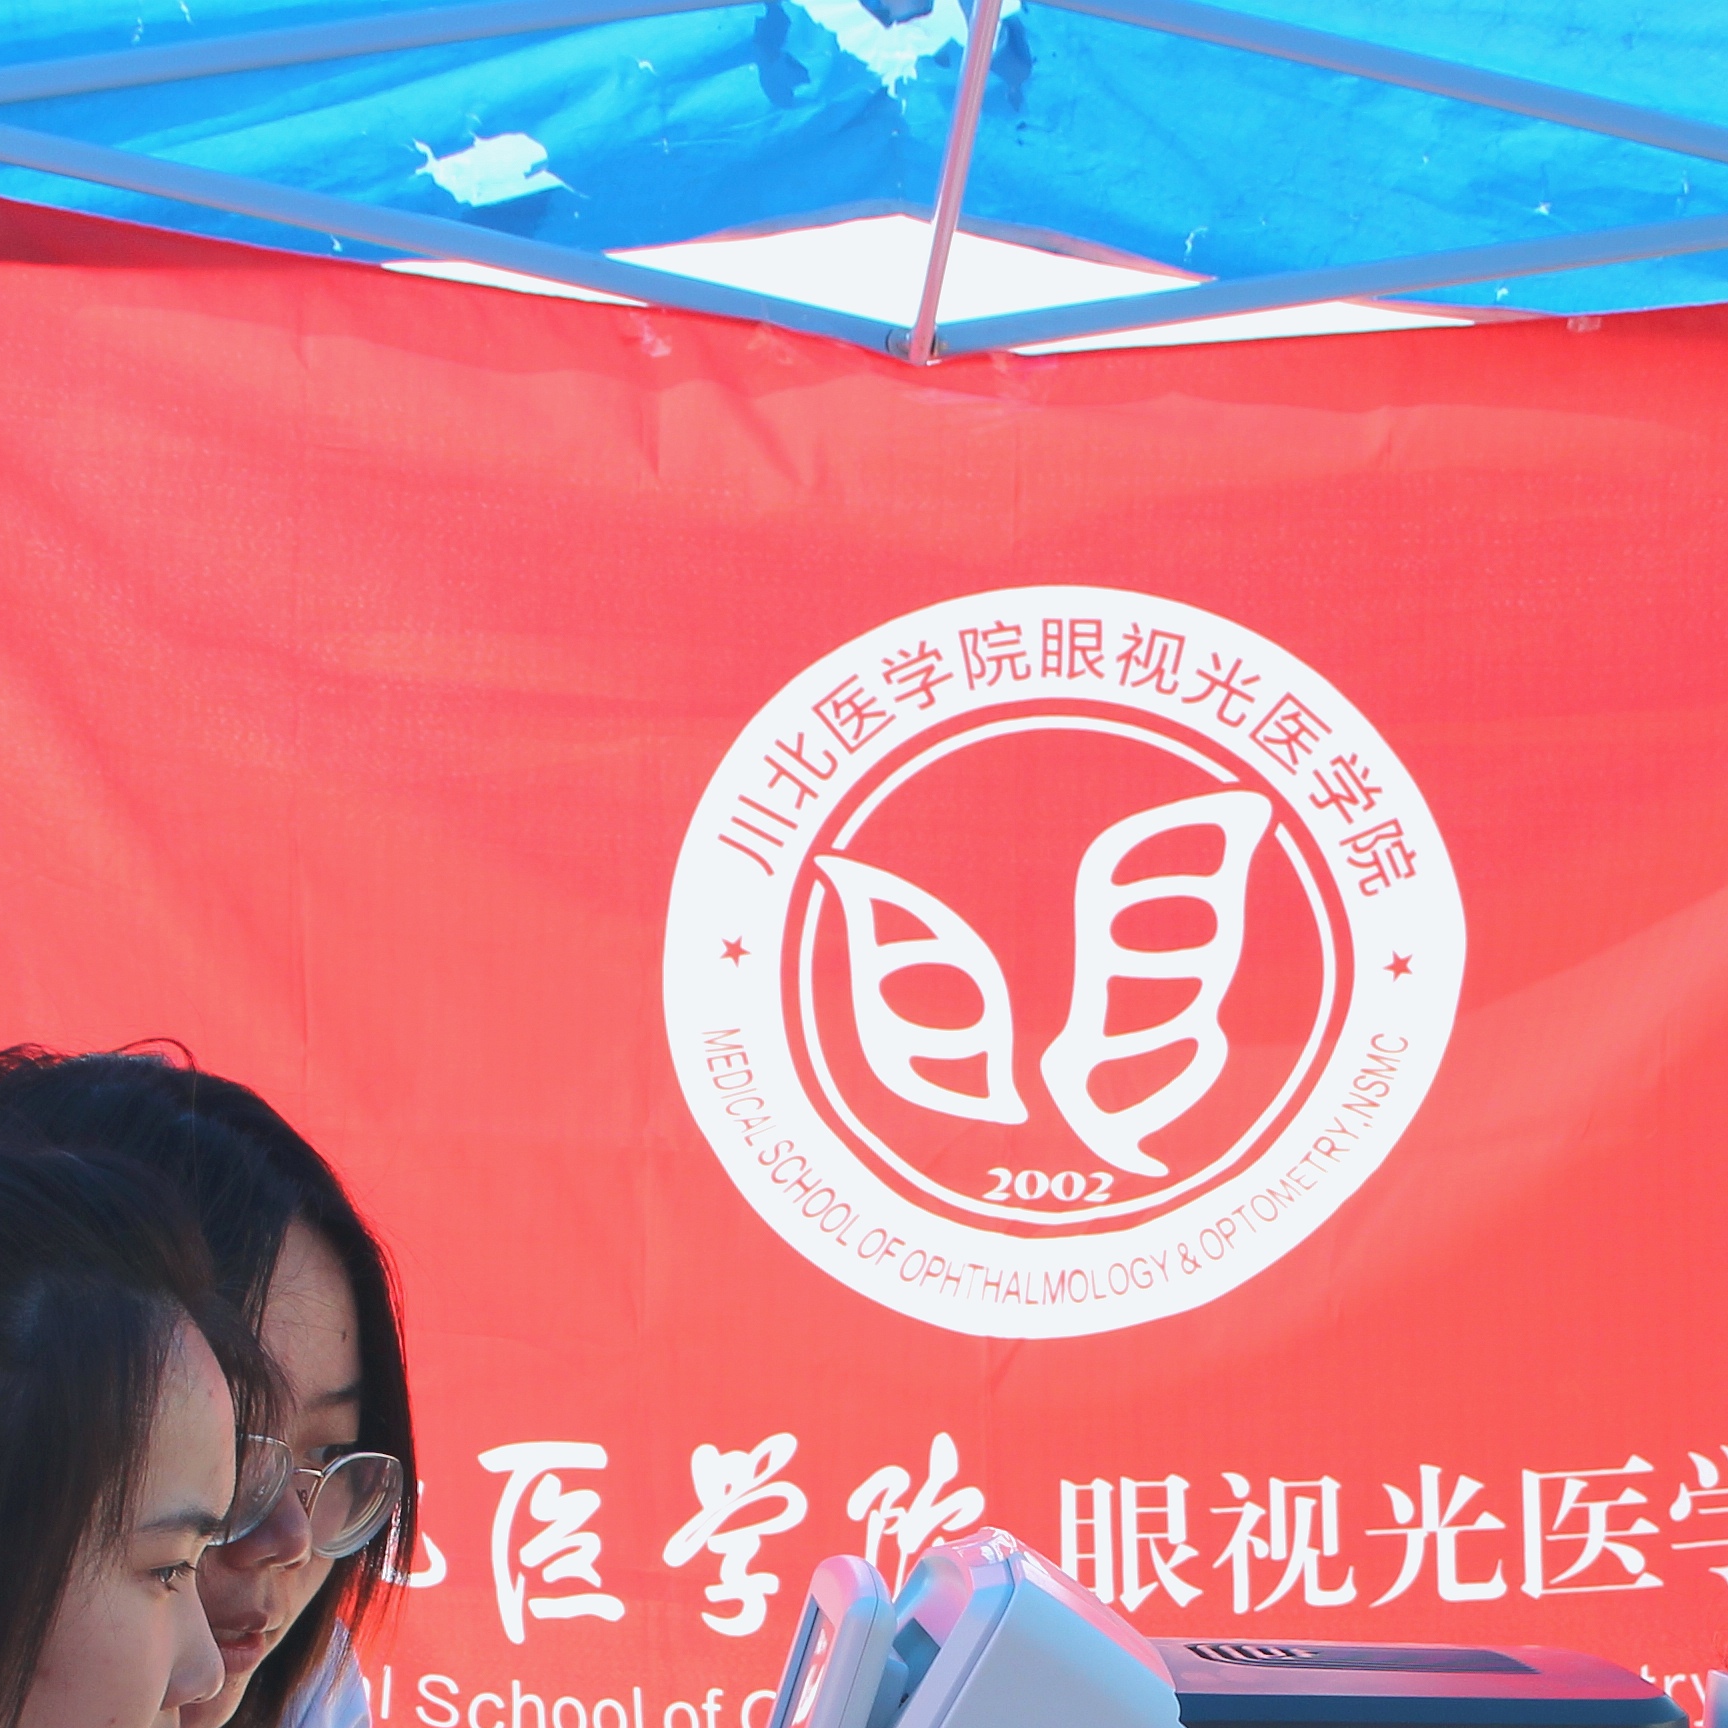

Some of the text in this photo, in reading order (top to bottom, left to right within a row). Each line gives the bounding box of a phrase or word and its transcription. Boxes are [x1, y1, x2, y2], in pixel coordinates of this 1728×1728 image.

[717, 617, 1418, 898] 川北医学院眼视光医学院
[701, 1027, 777, 1148] MEDICAL
[756, 1139, 861, 1248] SCHOOL
[857, 1227, 906, 1266] OF
[898, 1248, 1170, 1306] OPHTHALMOLOGY
[1176, 1242, 1203, 1276] &
[981, 1166, 1115, 1203] 2002
[382, 1432, 985, 1645] 医学院
